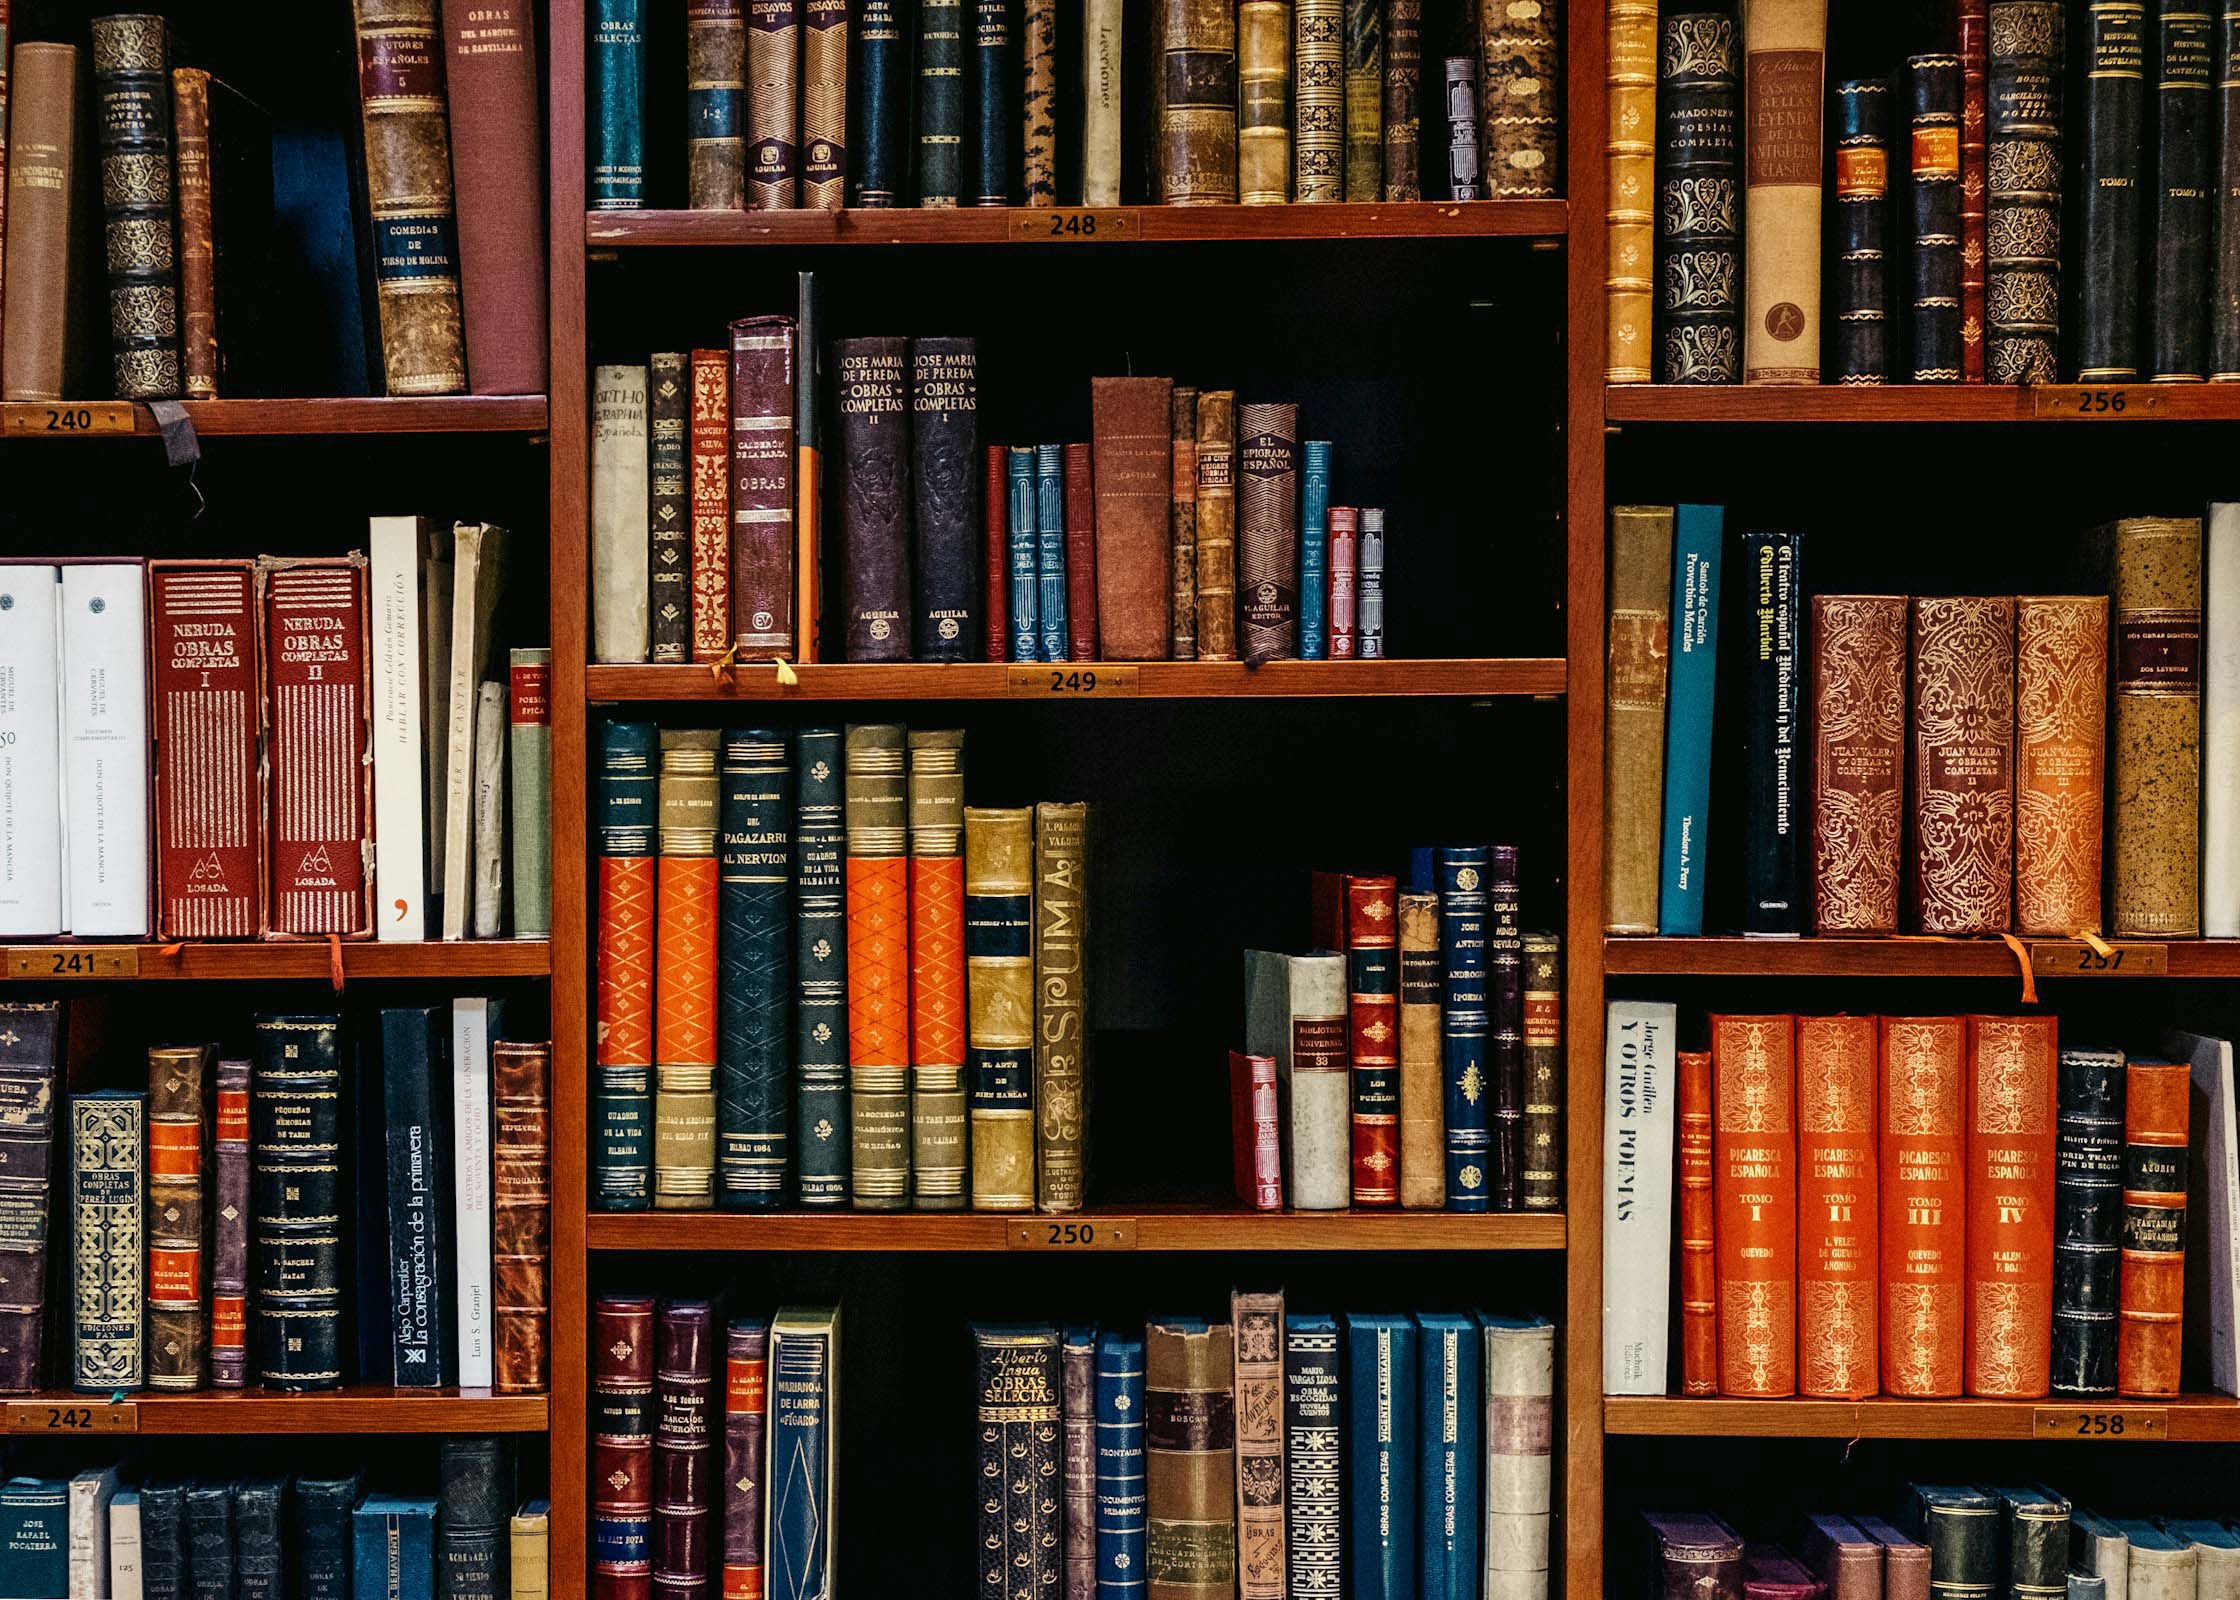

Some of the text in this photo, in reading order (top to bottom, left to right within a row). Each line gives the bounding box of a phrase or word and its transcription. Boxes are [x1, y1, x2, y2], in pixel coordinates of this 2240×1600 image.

[751, 2, 792, 14] ENSAYOS
[806, 1, 846, 13] ENSAYOS
[867, 2, 889, 11] AGUA
[469, 10, 510, 21] OBRAS
[601, 21, 634, 31] OBRAS
[594, 34, 642, 45] SELECTAS
[703, 108, 721, 120] 1-2
[1670, 109, 1708, 120] AMADO
[2099, 178, 2127, 188] TOMO
[2168, 188, 2196, 198] TOMO
[389, 224, 439, 236] COMEDIAS
[1051, 215, 1095, 235] 248
[408, 240, 422, 250] DE
[840, 356, 904, 370] JOSE MARIA
[913, 355, 977, 368] JOSE MARIA
[843, 370, 901, 382] DE PEREDA
[916, 368, 975, 381] DE PEREDA
[851, 384, 892, 398] OBRAS
[924, 382, 966, 396] OBRAS
[840, 399, 904, 413] COMPLETAS
[914, 397, 977, 411] COMPLETAS
[2079, 392, 2126, 412] 256
[47, 411, 91, 430] 240
[868, 415, 879, 425] II
[1260, 436, 1275, 447] EL
[1242, 447, 1291, 459] EPIGRAMA
[1242, 457, 1291, 471] ESPAÑOL
[740, 476, 787, 490] OBRAS
[1682, 552, 1698, 653] Proverbios Morales
[1696, 562, 1710, 644] Santob de Carrión
[860, 610, 900, 620] AGUILAR
[928, 609, 969, 619] AGUILAR
[173, 623, 237, 639] NERUDA
[283, 617, 345, 632] NERUDA
[173, 640, 235, 657] OBRAS
[283, 634, 344, 651] OBRAS
[171, 656, 241, 669] COMPLETAS
[280, 650, 349, 663] COMPLETAS
[201, 672, 211, 688] I
[1050, 671, 1095, 692] 249
[1775, 545, 1792, 834] El teatro español Medieval del Renacimiento
[1831, 747, 1858, 761] JUAN
[1938, 747, 2002, 761] JUAN VALERA
[1850, 758, 1883, 768] OBRAS
[1957, 757, 1989, 768] OBRAS
[1836, 766, 1892, 778] COMPLETAS
[1944, 766, 1998, 777] COMPLETAS
[724, 832, 788, 845] PAGAZARRI
[724, 851, 787, 868] AL NERVION
[1678, 816, 1692, 890] Theodore Perry
[295, 876, 337, 887] LOSADA
[187, 883, 229, 894] LOSADA
[1494, 902, 1519, 912] COPLAS
[1501, 915, 1511, 924] DE
[1460, 923, 1480, 933] JOSE
[1496, 927, 1517, 937] MINGO
[53, 954, 94, 973] 241
[1315, 1056, 1329, 1067] 33
[1642, 1021, 1659, 1114] Jorge Guillén
[1370, 1080, 1387, 1089] LOS
[1616, 1021, 1639, 1222] Y OTROS POEMAS
[1729, 1147, 1781, 1163] PICARESCA
[1813, 1147, 1865, 1163] PICARESCA
[1899, 1149, 1951, 1165] PICARESCA
[1987, 1148, 2038, 1163] PICARESCA
[1730, 1162, 1780, 1179] ESPAÑOLA
[1814, 1162, 1864, 1179] ESPAÑOLA
[2081, 1160, 2095, 1169] DE
[91, 1170, 120, 1182] OBRAS
[1900, 1164, 1950, 1181] ESPAÑOLA
[1987, 1163, 2038, 1180] ESPAÑOLA
[82, 1180, 130, 1191] COMPLETAS
[1738, 1193, 1774, 1205] TOMO
[1823, 1194, 1857, 1205] TOMO
[1907, 1196, 1943, 1207] TOMO
[1995, 1195, 2030, 1207] TOMO
[1751, 1205, 1762, 1222] I
[1829, 1205, 1852, 1222] II
[1907, 1208, 1943, 1225] III
[1999, 1207, 2025, 1224] IV
[408, 1125, 432, 1346] La consagración de la primavera
[1049, 1225, 1094, 1244] 250
[1740, 1247, 1774, 1259] QUEVEDO
[1907, 1249, 1943, 1261] QUEVEDO
[398, 1258, 414, 1316] Carpentier
[470, 1284, 482, 1358] Luis Granjel
[83, 1324, 131, 1335] EDICIONES
[95, 1332, 117, 1342] FAX
[991, 1349, 1048, 1364] Alberto
[998, 1364, 1041, 1377] Insua
[1302, 1366, 1324, 1375] MARIO
[991, 1375, 1047, 1391] OBRAS
[1289, 1375, 1338, 1385] VARGAS LLOSA
[1380, 1331, 1389, 1442] VICENTE ALEIXANDRE
[778, 1382, 814, 1394] MARIANO
[1301, 1387, 1328, 1396] OBRAS
[1445, 1332, 1455, 1442] VICENTE ALEIXANDRE
[984, 1389, 1055, 1403] SELECTAS
[1290, 1394, 1338, 1403] ESCOGIDAS
[781, 1399, 820, 1410] DE LARRA
[1300, 1402, 1329, 1410] NOVELAS
[48, 1409, 93, 1428] 242
[1299, 1408, 1330, 1417] CUENTOS
[1170, 1415, 1209, 1424] BOSCAN
[2077, 1415, 2125, 1434] 258
[1380, 1450, 1389, 1537] OBRAS COMPLETAS
[1445, 1450, 1455, 1537] OBRAS COMPLETAS
[23, 1519, 45, 1529] JOSE
[389, 1529, 398, 1591] BENAVENTE
